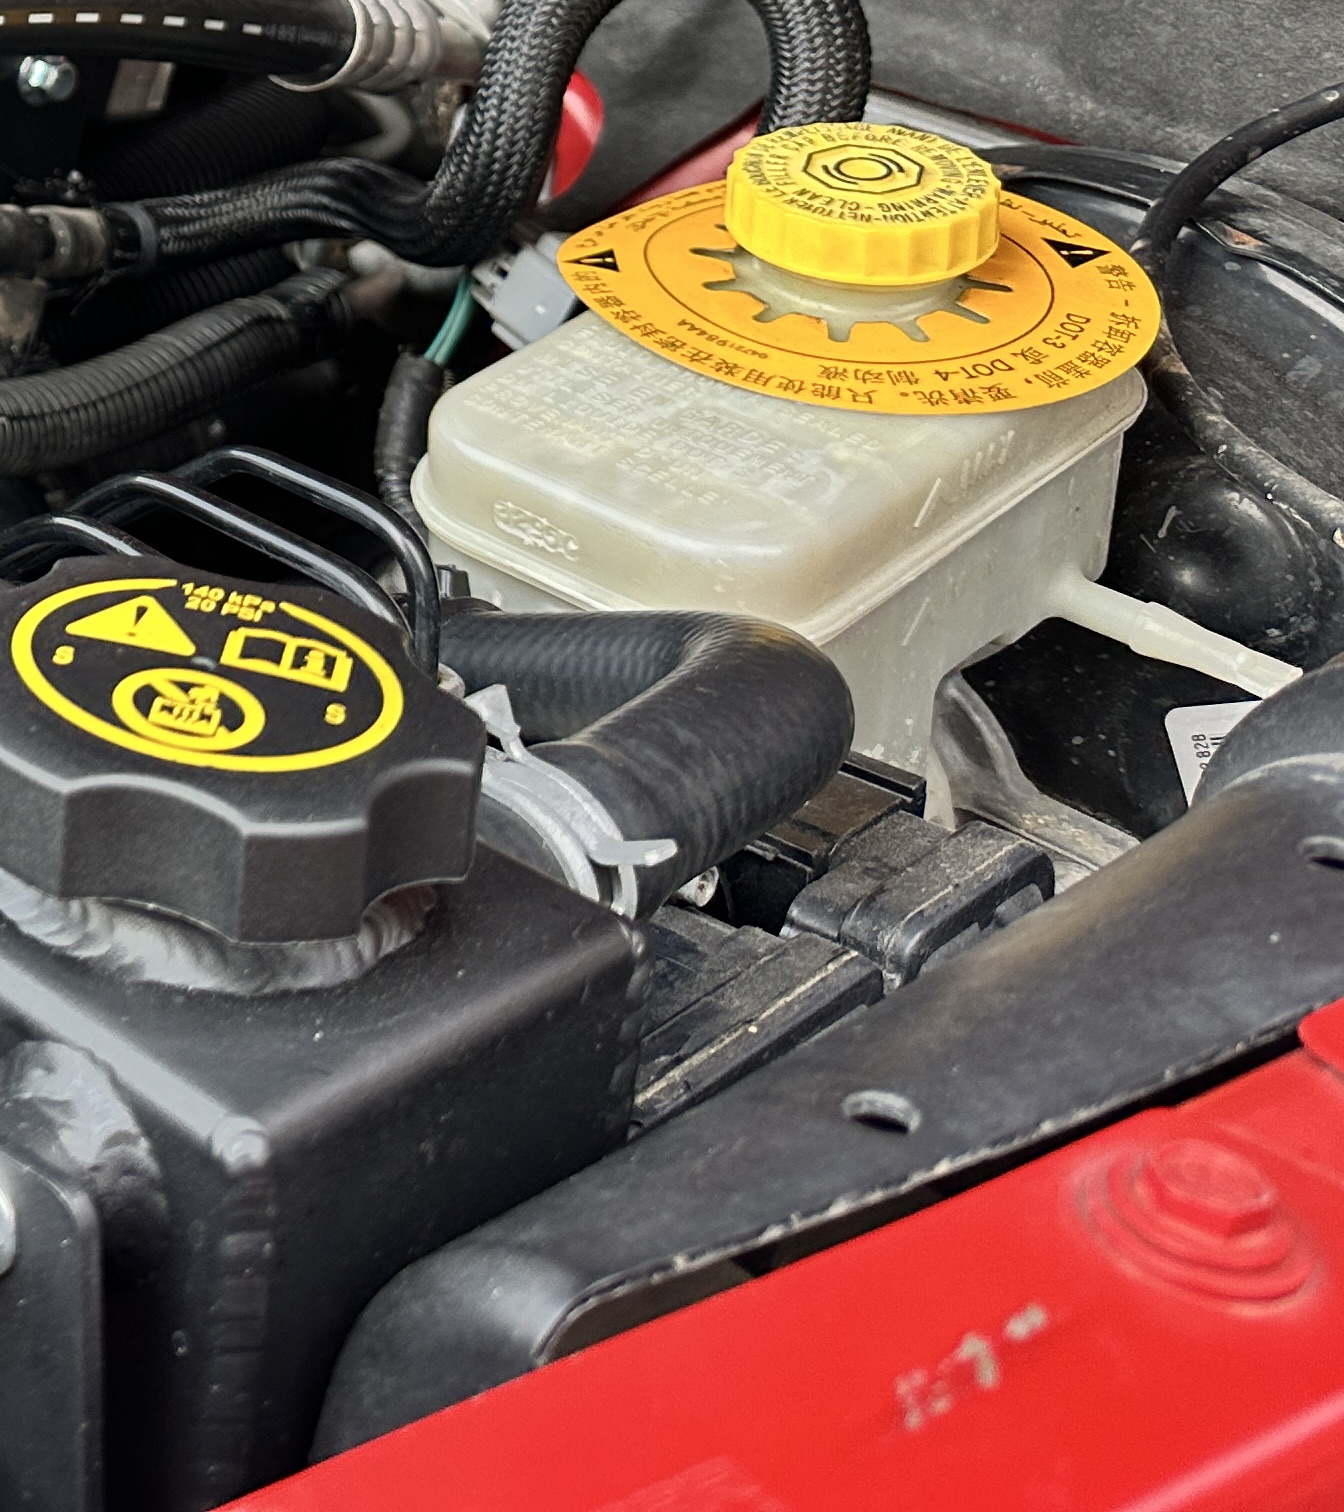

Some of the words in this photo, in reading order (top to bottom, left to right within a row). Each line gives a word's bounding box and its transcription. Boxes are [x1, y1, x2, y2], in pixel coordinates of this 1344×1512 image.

[1033, 312, 1099, 350] DOT-3
[1009, 344, 1053, 367] 或
[931, 355, 1016, 386] DOT-4
[181, 581, 225, 604] 140
[184, 595, 214, 615] 20
[220, 600, 265, 624] PSI
